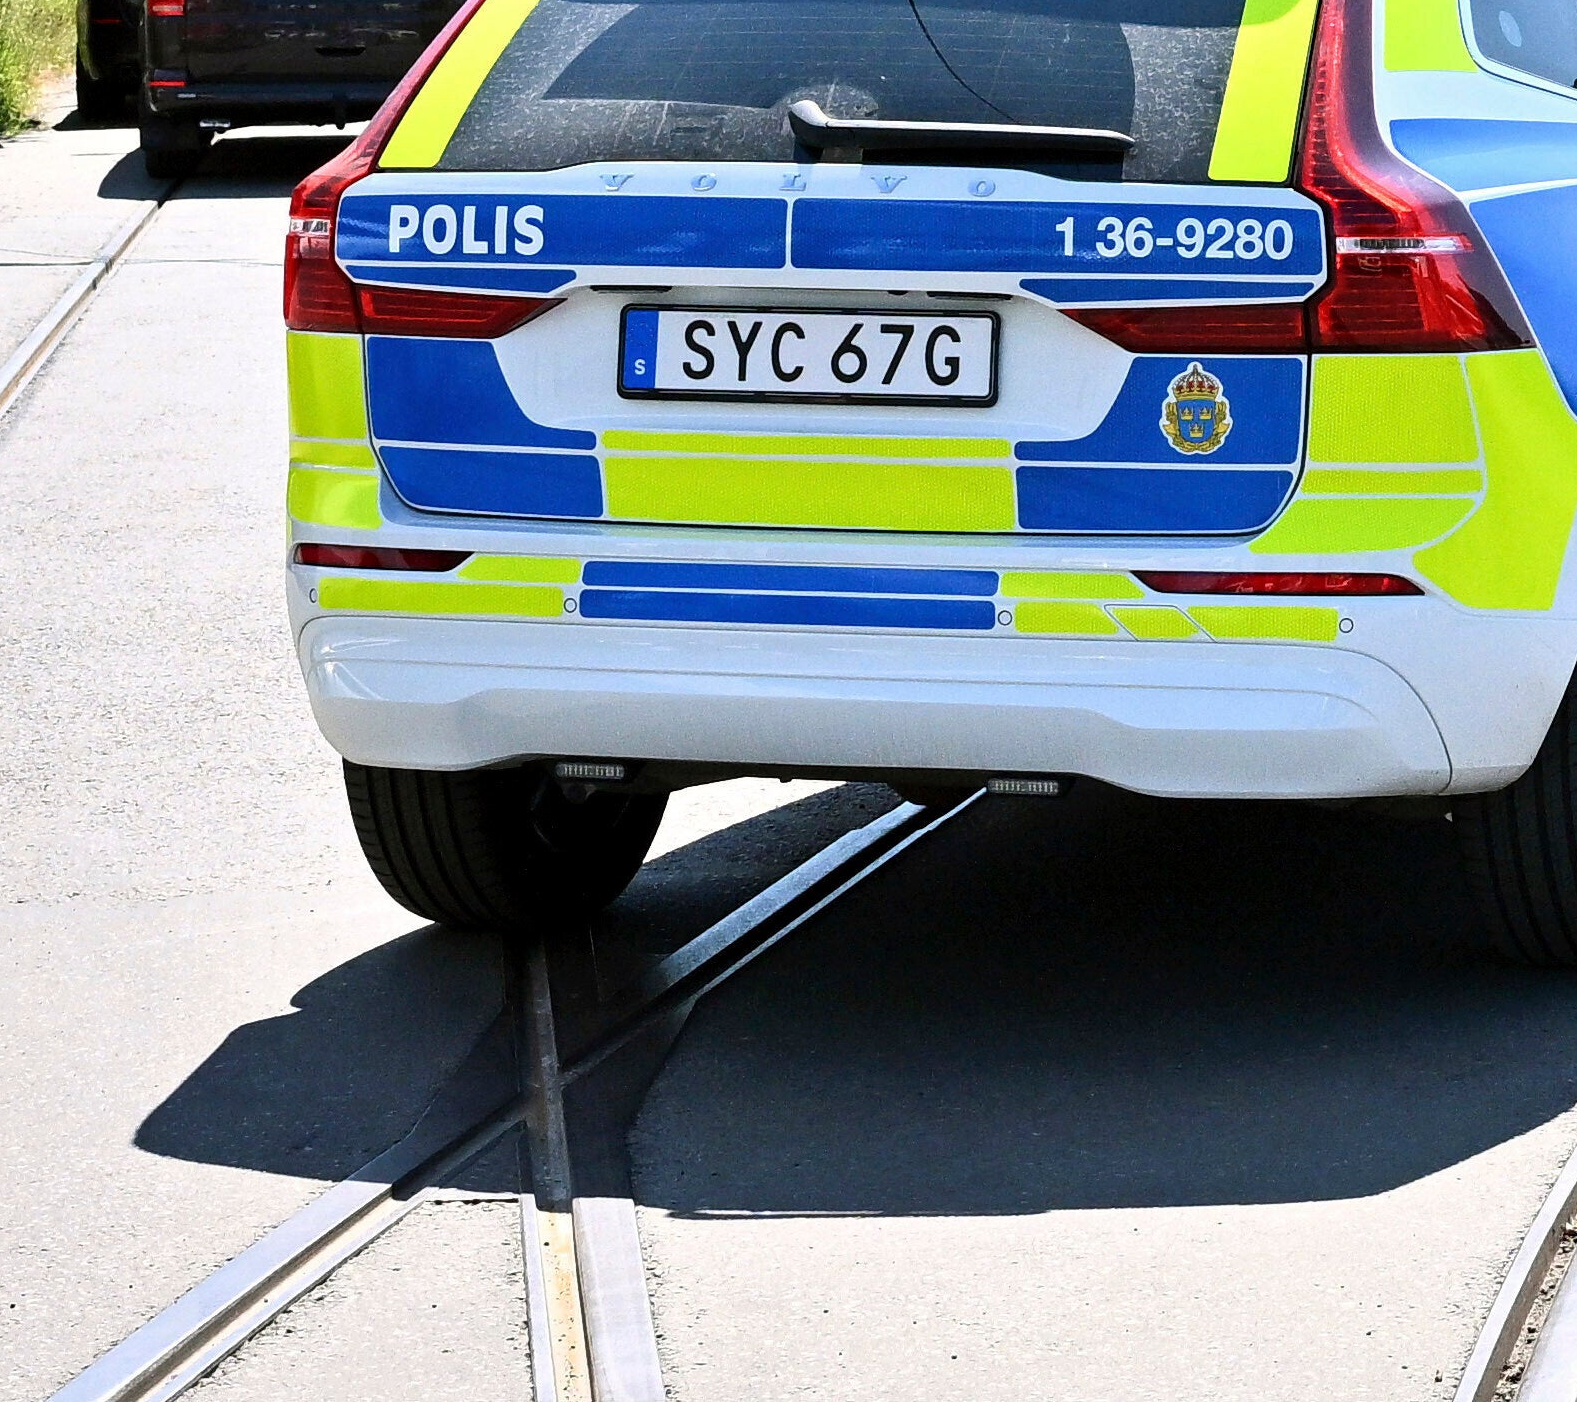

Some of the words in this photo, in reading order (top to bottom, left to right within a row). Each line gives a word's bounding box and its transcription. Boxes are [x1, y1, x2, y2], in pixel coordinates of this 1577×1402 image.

[599, 172, 997, 197] VOLVO
[388, 204, 545, 256] POLIS
[1055, 216, 1074, 256] 1
[1095, 216, 1294, 260] 36-9280
[634, 358, 646, 376] S
[682, 319, 806, 383] SYC
[830, 322, 962, 386] 67G
